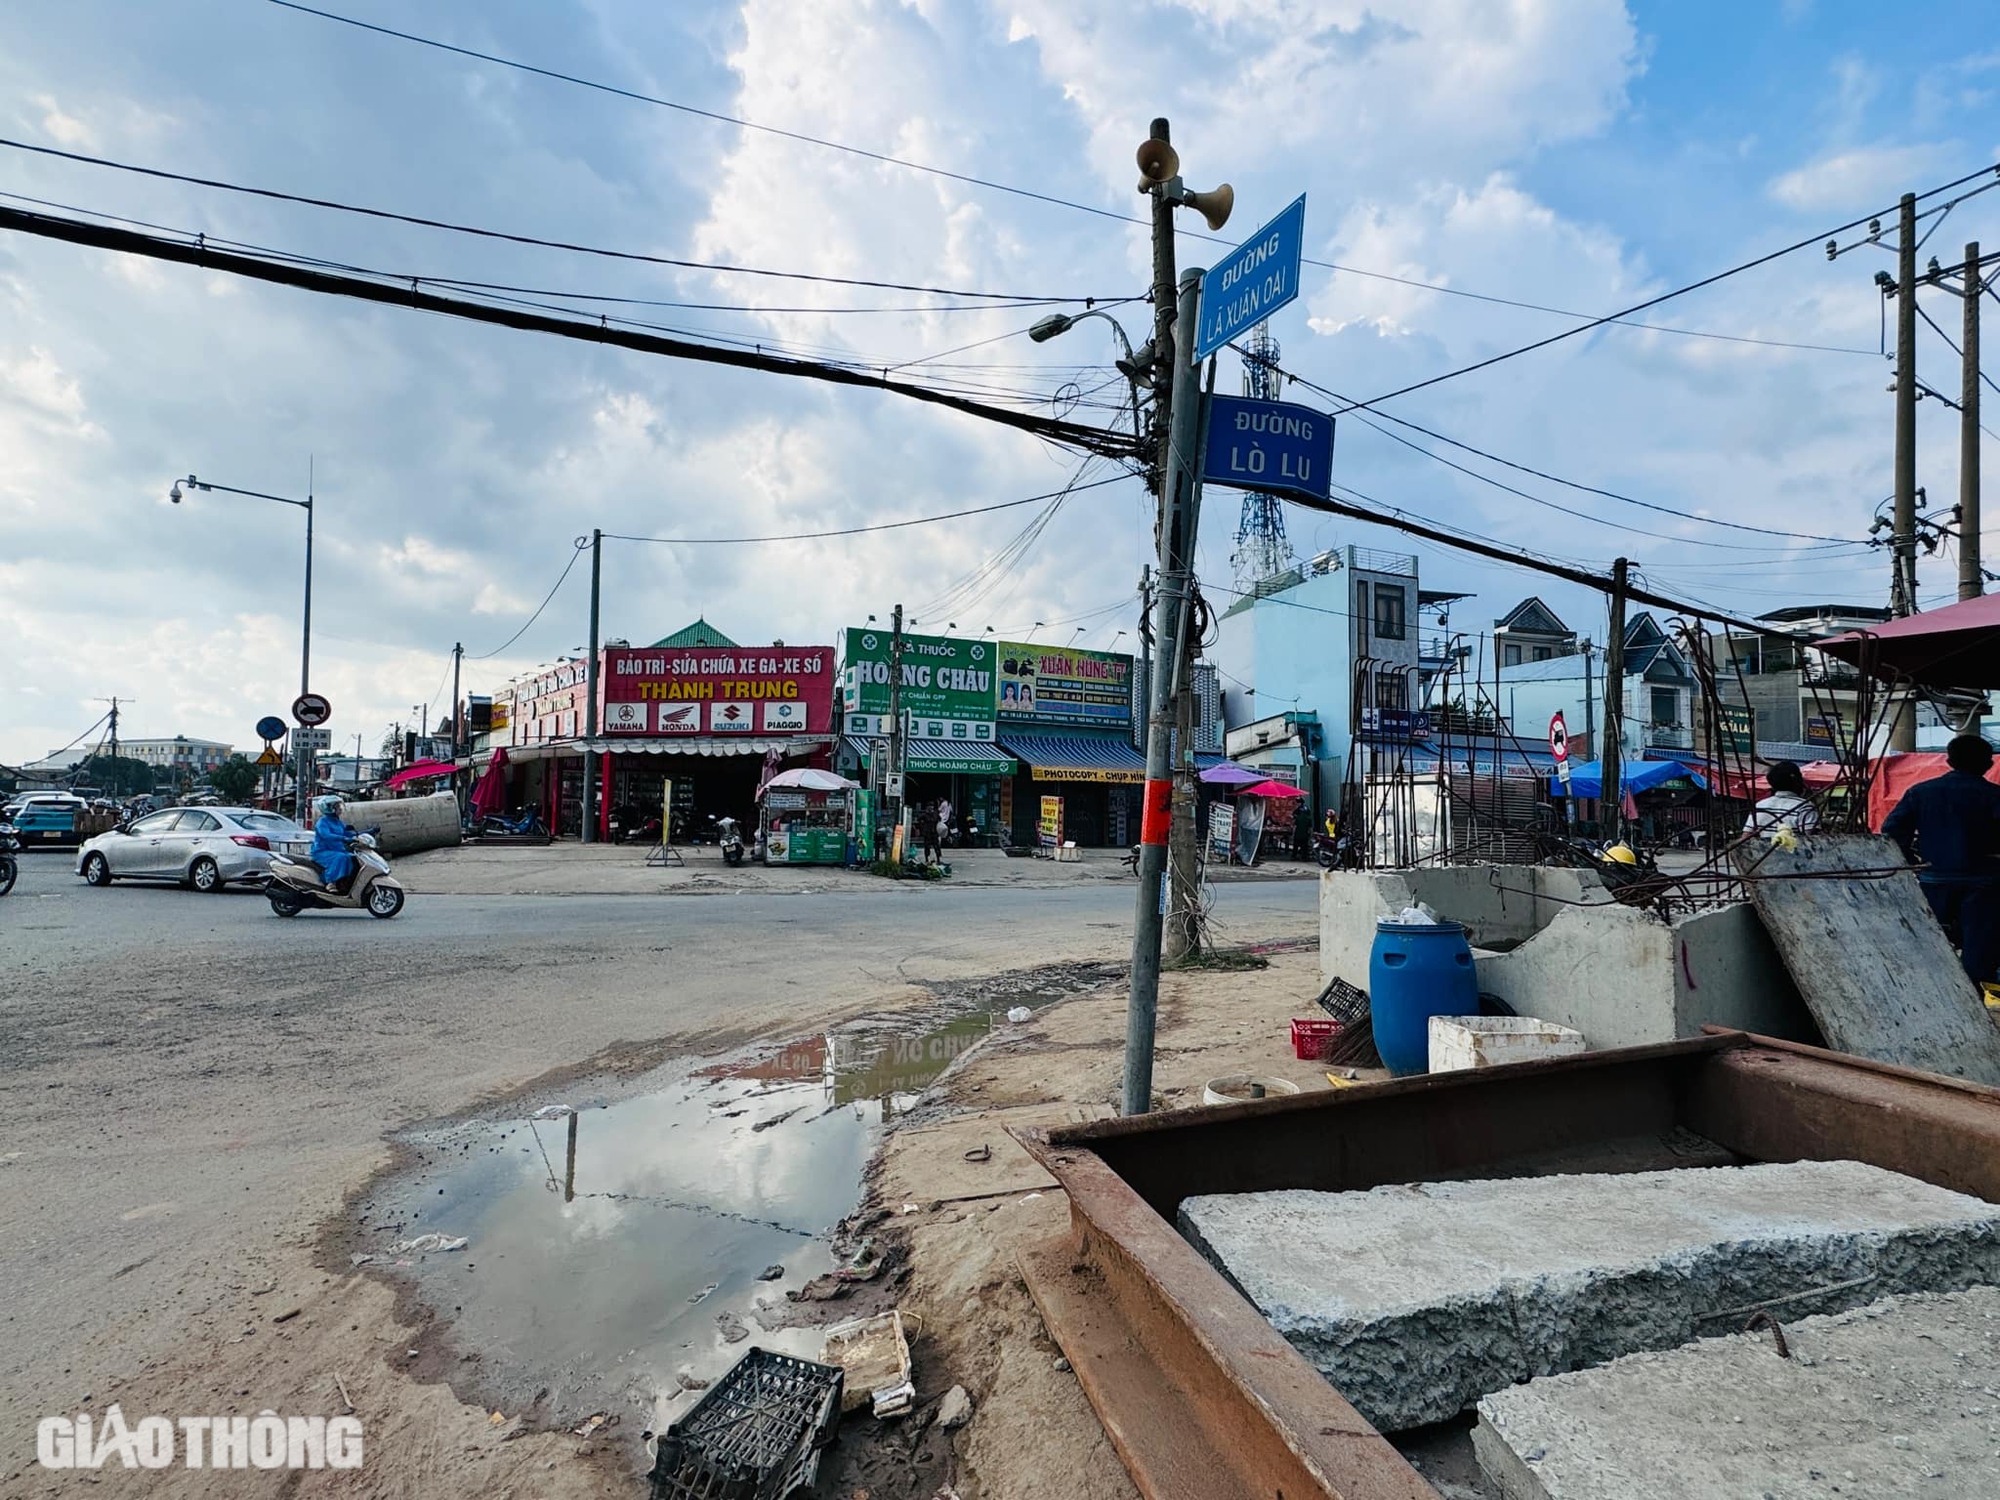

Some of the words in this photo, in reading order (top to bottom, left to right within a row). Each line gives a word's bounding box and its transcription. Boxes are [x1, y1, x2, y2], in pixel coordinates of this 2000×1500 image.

[1221, 232, 1280, 292] ĐƯỜNG
[1225, 286, 1260, 332] XUÂN
[1263, 265, 1286, 305] OAI
[1234, 410, 1314, 441] ĐƯỜNG
[1230, 441, 1265, 473] LÒ
[1281, 452, 1311, 482] LU
[918, 640, 956, 657] THUỐC
[616, 653, 642, 675] BẢO
[701, 654, 736, 675] CHỮA
[739, 658, 756, 674] XE
[804, 651, 823, 674] SỐ
[1039, 653, 1073, 676] XUÂN
[638, 677, 714, 699] THÀNH
[721, 680, 798, 699] TRUNG
[937, 665, 991, 693] CHÂU
[608, 722, 644, 731] YAMAHA
[661, 722, 696, 731] HONDA
[714, 722, 750, 731] SUZUKI
[767, 720, 803, 729] PIAGGIO
[910, 758, 938, 769] THUỐC
[939, 759, 968, 770] HOÀNG
[970, 760, 992, 771] CHÂU
[1044, 770, 1098, 779] PHOTOCOPY
[1131, 770, 1145, 781] HÌN
